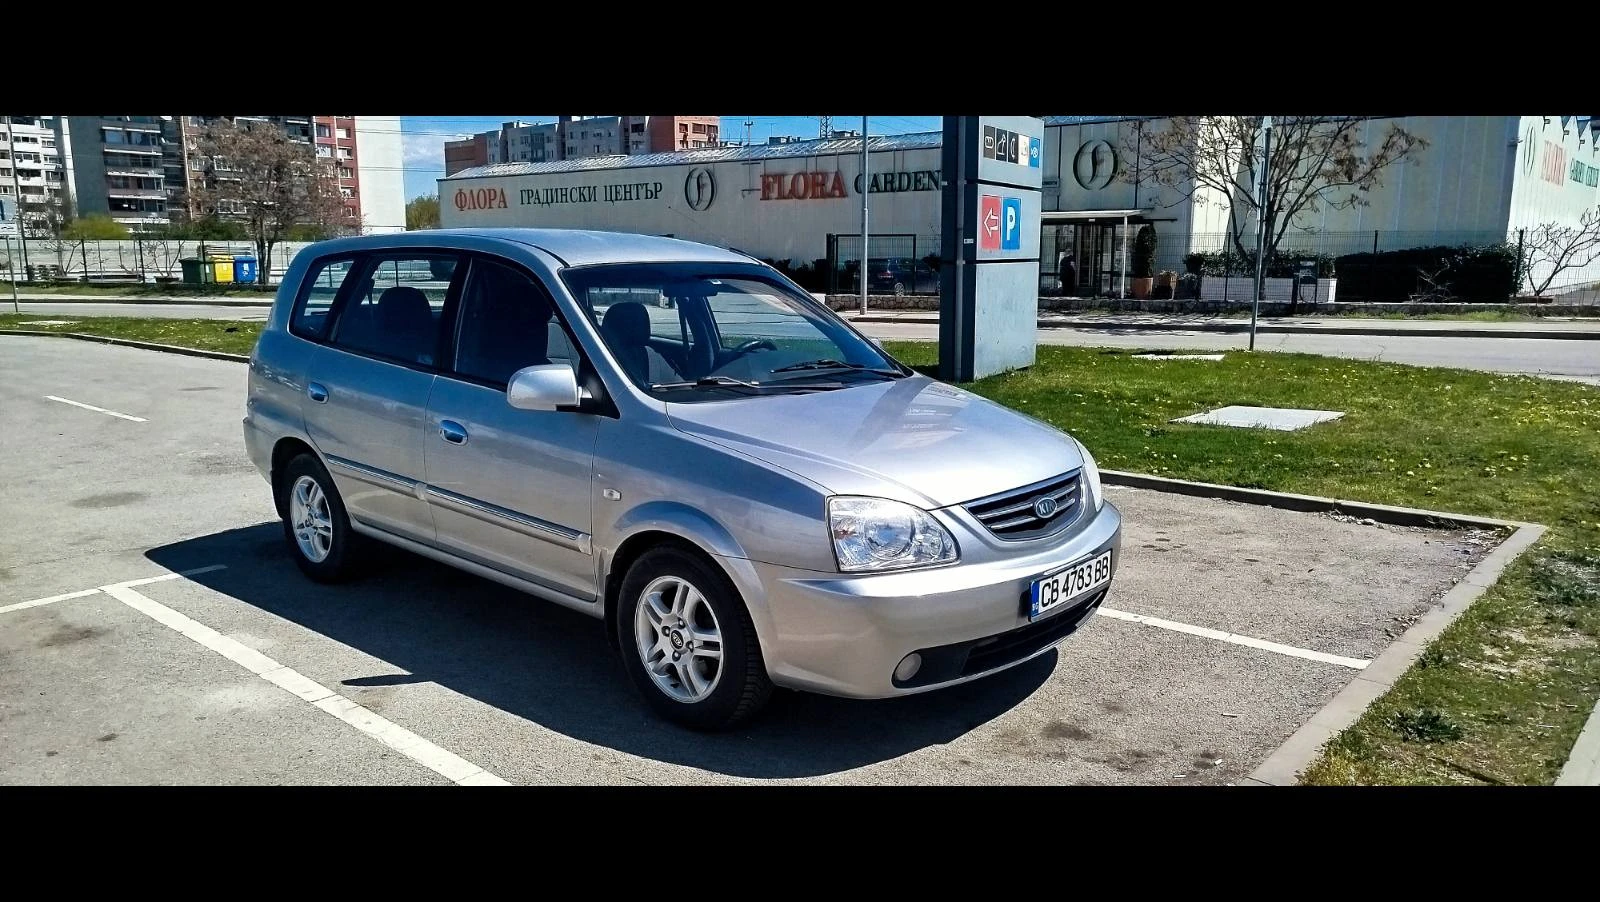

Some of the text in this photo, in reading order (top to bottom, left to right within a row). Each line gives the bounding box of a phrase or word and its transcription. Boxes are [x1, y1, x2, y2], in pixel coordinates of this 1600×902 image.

[455, 182, 663, 211] ФЛОРА ГРАДИНСКИ ЦЕНТЪР
[760, 170, 848, 200] FLORA
[1006, 206, 1016, 240] P
[1039, 500, 1055, 515] KIA
[1041, 556, 1108, 607] CB 4783 BB
